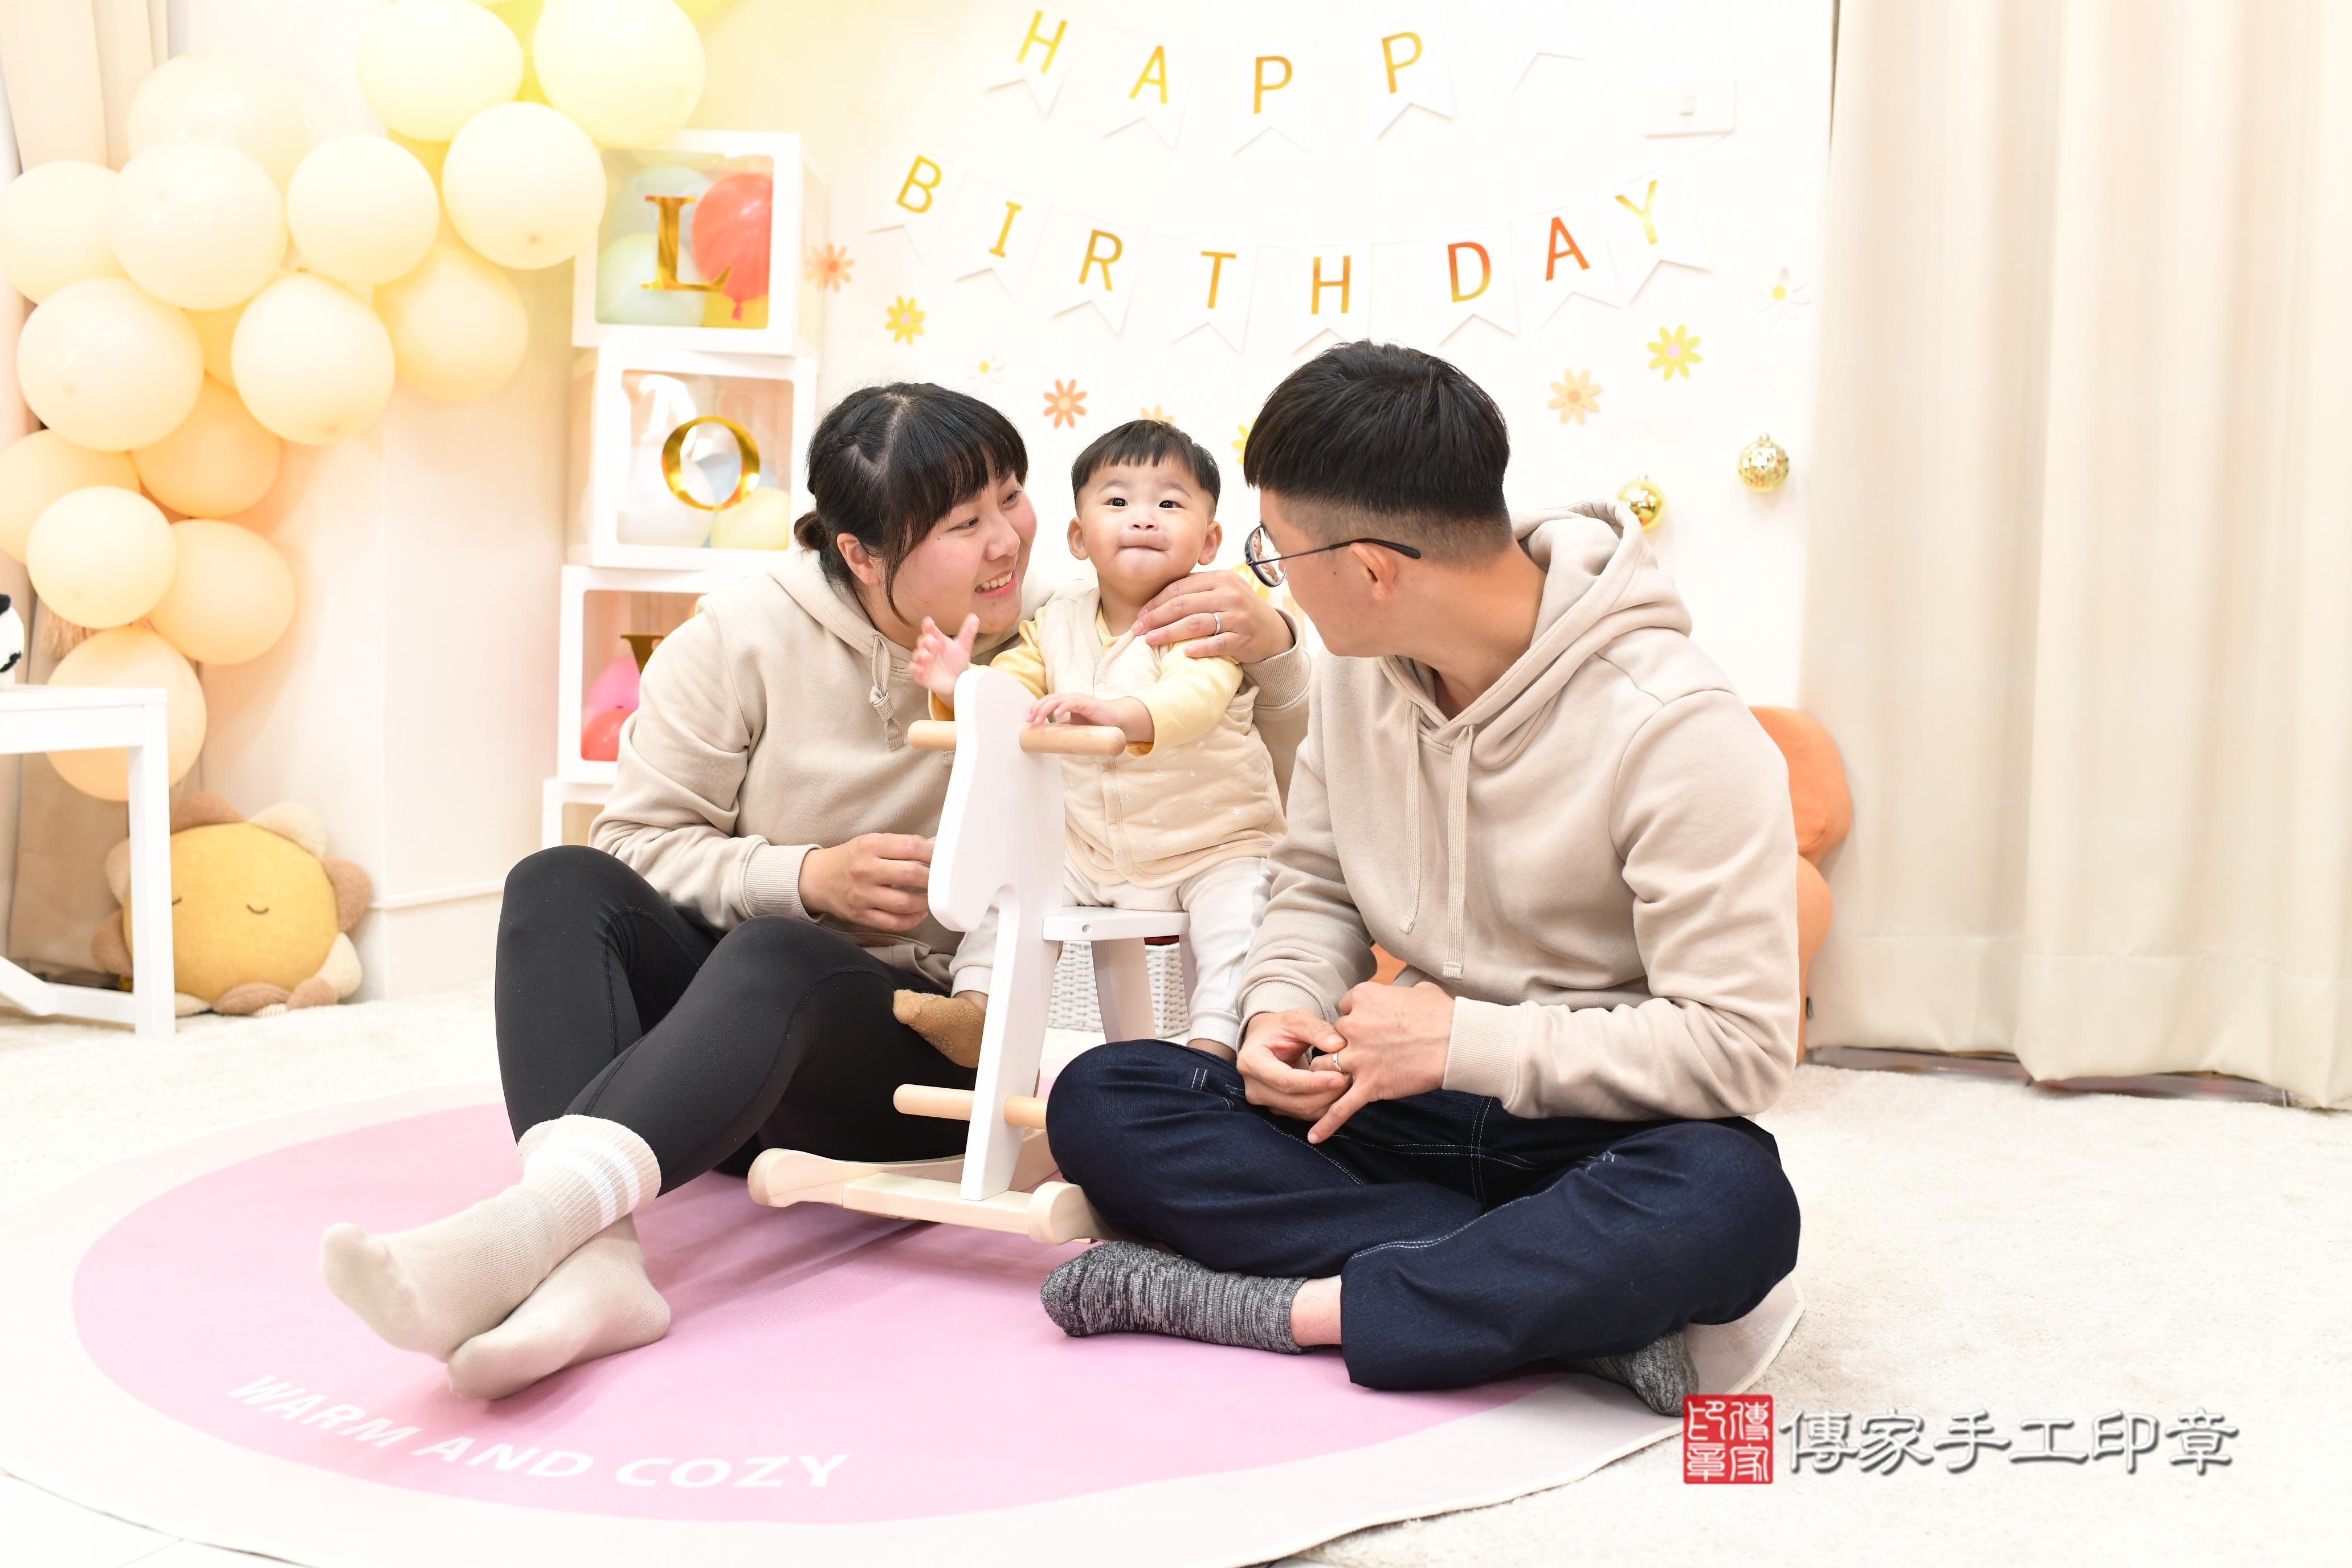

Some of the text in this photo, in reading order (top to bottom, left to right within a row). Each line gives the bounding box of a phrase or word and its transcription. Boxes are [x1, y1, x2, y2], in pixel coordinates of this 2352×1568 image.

[1016, 9, 1537, 115] HAPP
[895, 154, 1659, 316] BIRTHDAY
[226, 1374, 850, 1489] WARM AND COZY
